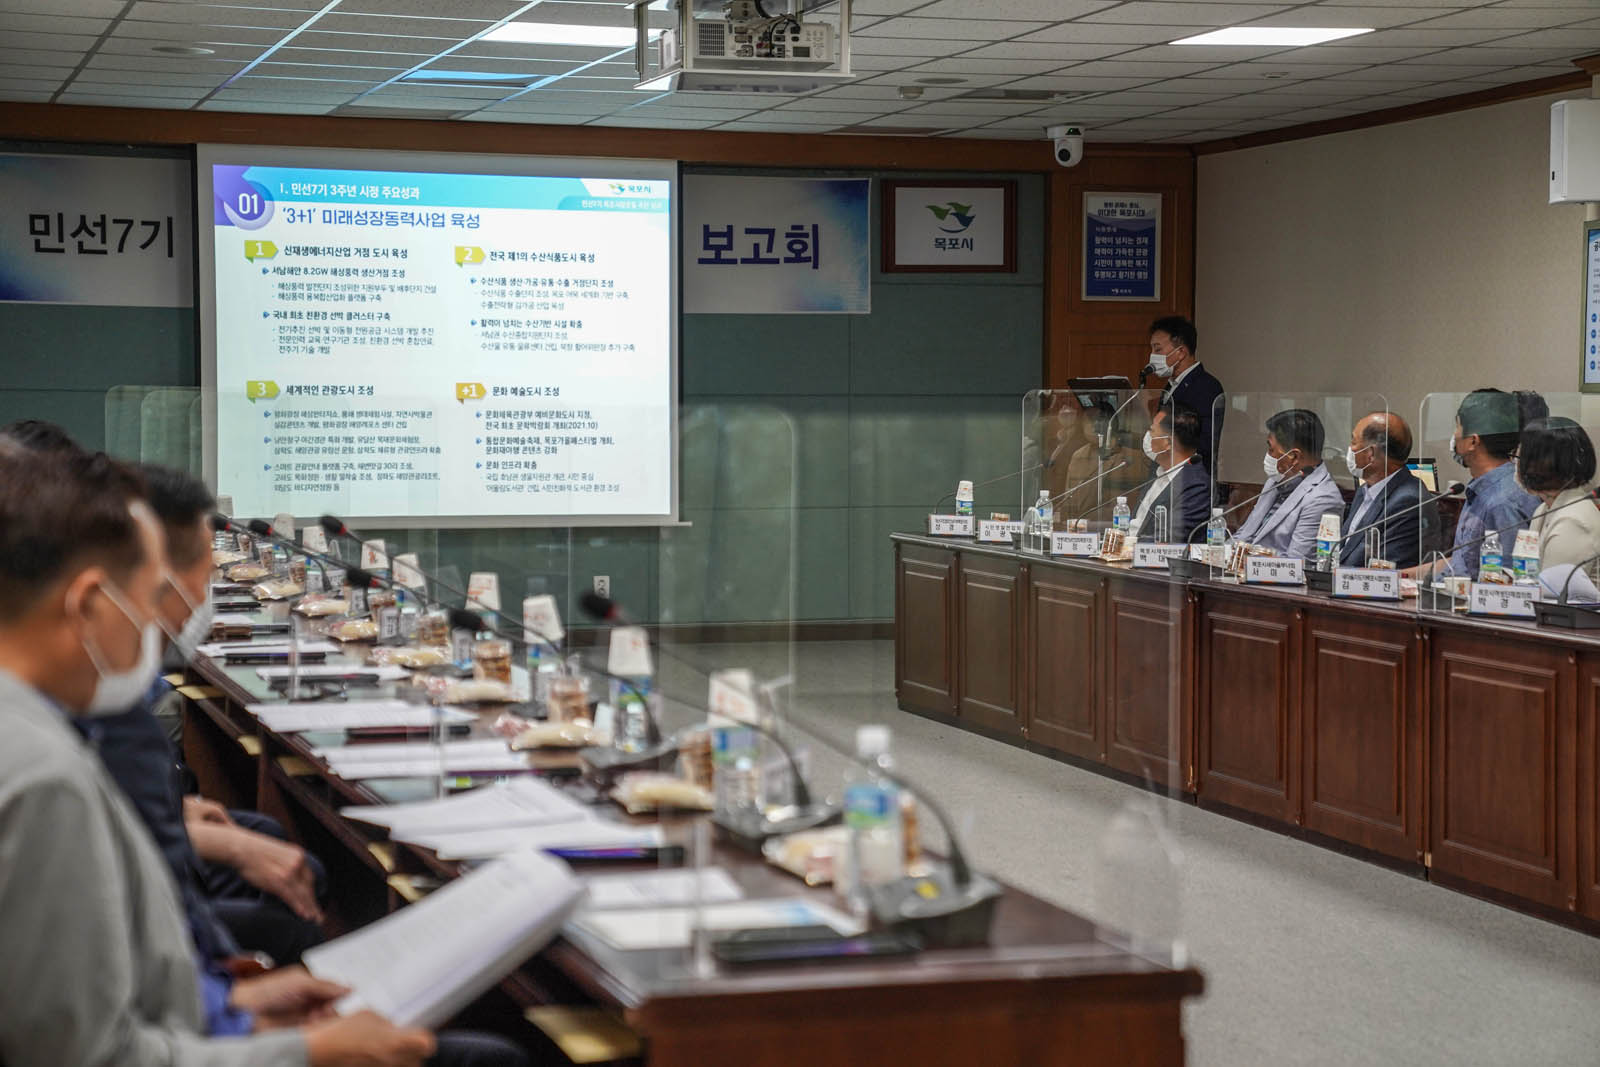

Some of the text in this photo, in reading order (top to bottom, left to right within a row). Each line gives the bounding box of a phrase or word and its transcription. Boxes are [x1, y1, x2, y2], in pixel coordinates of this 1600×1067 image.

[292, 184, 420, 199] 민선7기 3주년 시정 주요성과
[238, 193, 258, 215] 01
[322, 209, 446, 228] 미래성장동력사업
[450, 213, 480, 230] 육성
[29, 212, 174, 258] 민선7기
[255, 242, 264, 256] 1
[698, 224, 819, 269] 보고회
[934, 238, 974, 251] 목포시
[284, 246, 408, 260] 신재생에너지산업 거점 도시 육성
[464, 248, 472, 260] 2
[490, 251, 596, 264] 전국 제1의 수산식품도시 육성
[272, 266, 406, 278] 서남해안 8.2GW 해상풍력 생산거점 조성
[481, 277, 507, 286] 수산식품
[601, 279, 614, 288] 조성
[273, 311, 390, 321] 국내 최초 친환경 선박 클러스터 구축
[256, 382, 266, 396] 3
[286, 385, 374, 396] 세계적인 관광도시 조성
[462, 384, 478, 397] +1
[492, 386, 560, 398] 문화 예술도시 조성
